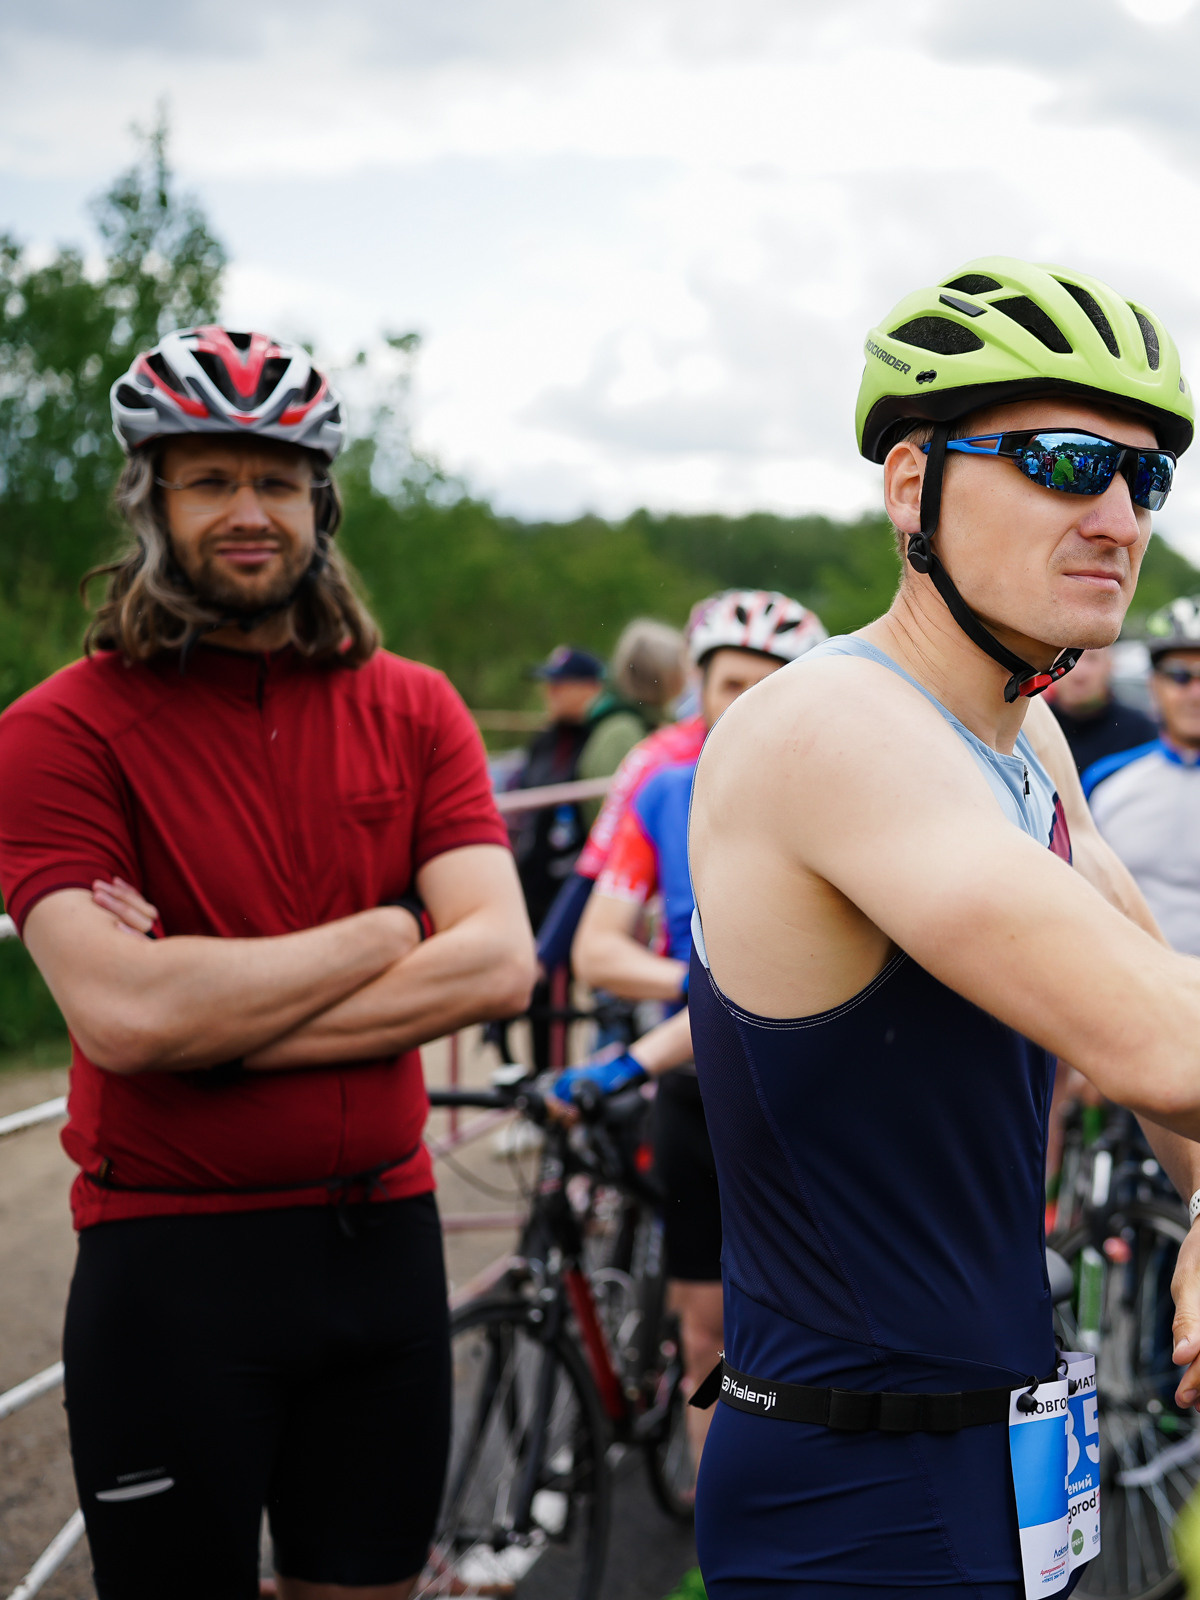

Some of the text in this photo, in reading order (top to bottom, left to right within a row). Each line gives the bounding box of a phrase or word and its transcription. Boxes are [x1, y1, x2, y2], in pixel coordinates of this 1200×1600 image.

[729, 1379, 777, 1411] Kalenji
[1025, 1374, 1096, 1417] ОВГО ИАТ
